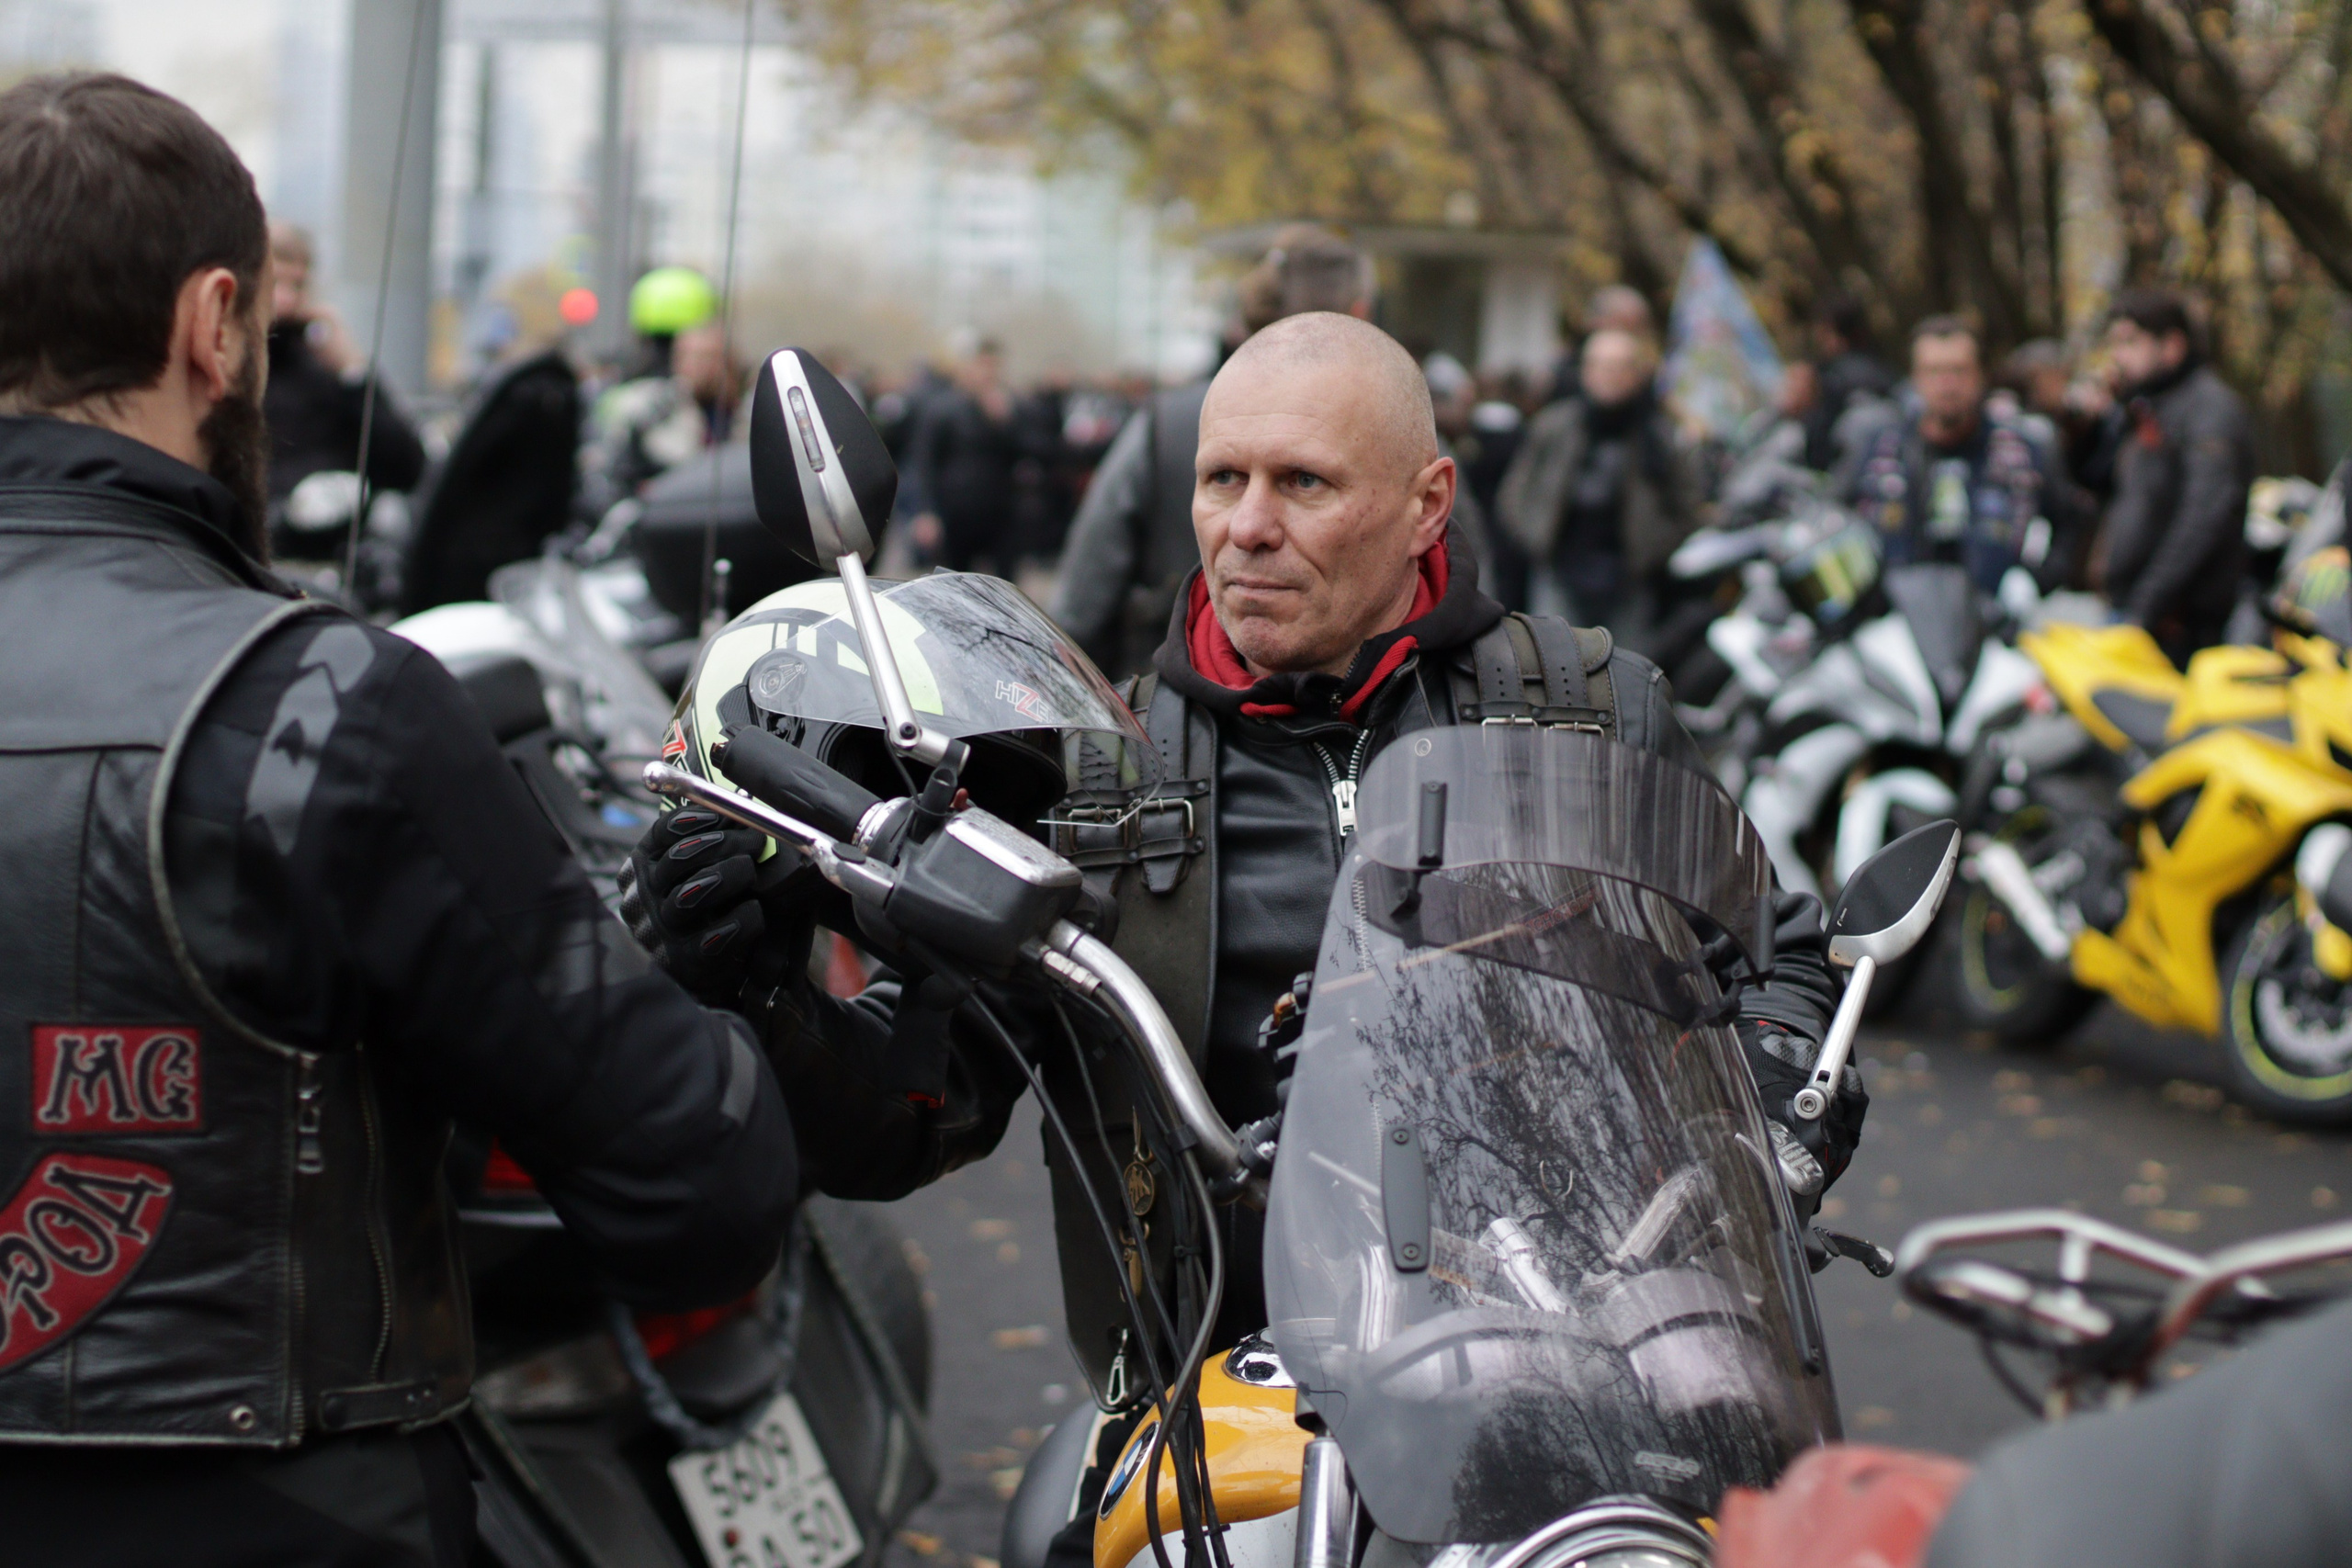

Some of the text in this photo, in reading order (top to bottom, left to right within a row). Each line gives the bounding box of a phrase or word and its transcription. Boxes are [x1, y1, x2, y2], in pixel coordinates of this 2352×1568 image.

[0, 1163, 174, 1352] РОД
[703, 1425, 798, 1517] 5609
[791, 1500, 844, 1565] 50
